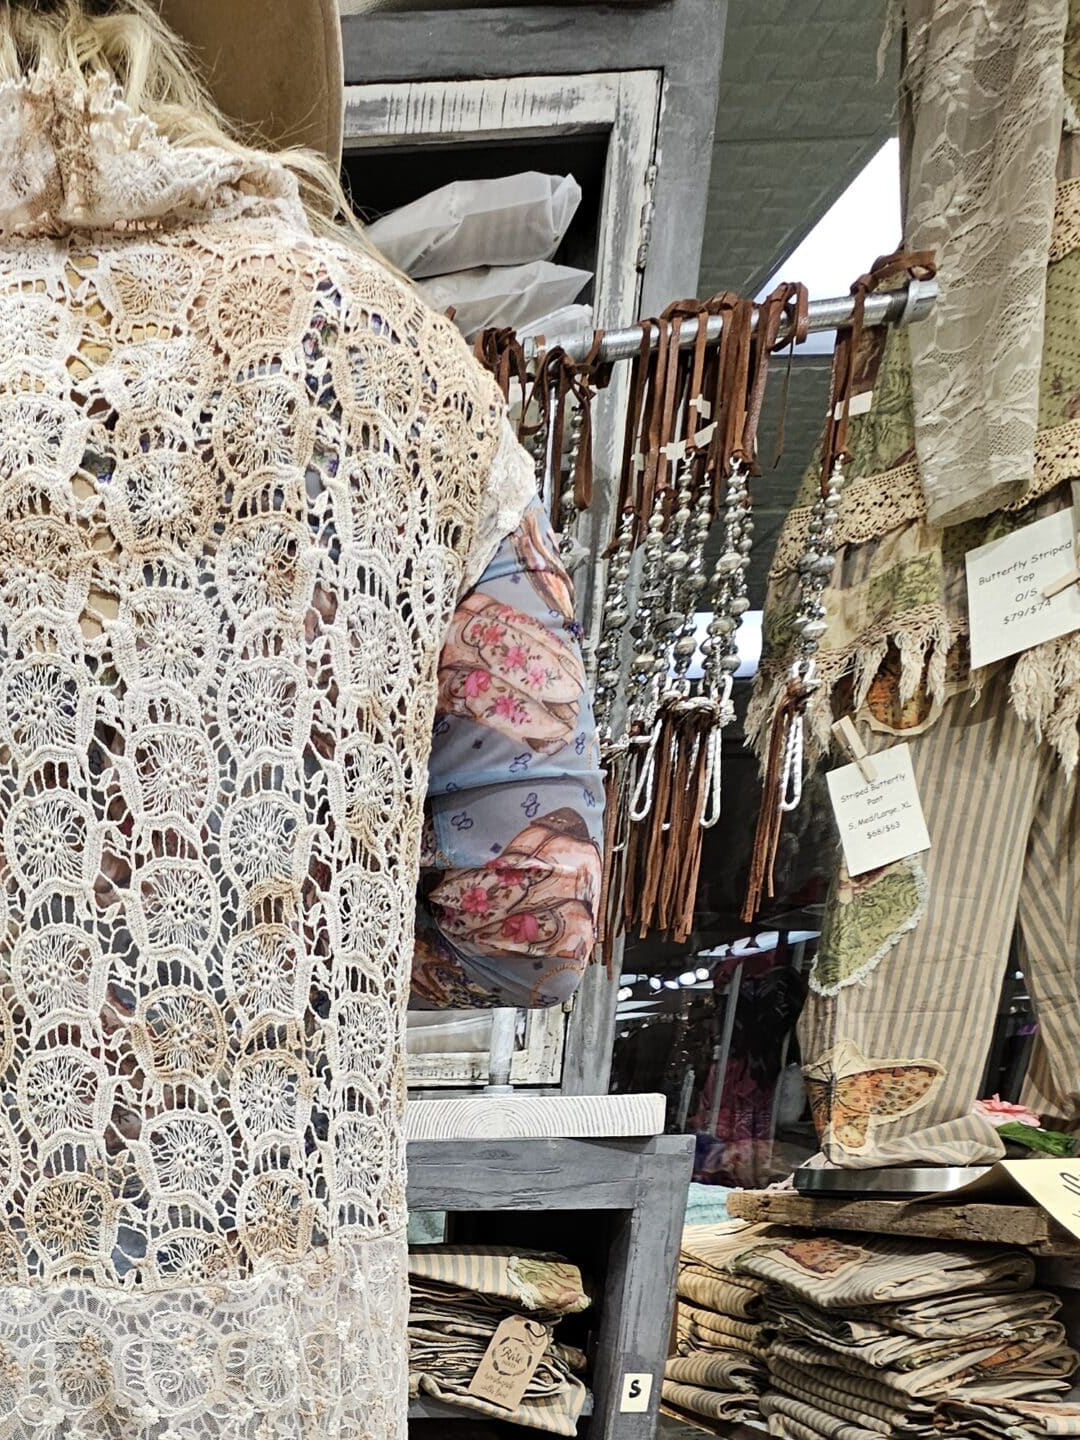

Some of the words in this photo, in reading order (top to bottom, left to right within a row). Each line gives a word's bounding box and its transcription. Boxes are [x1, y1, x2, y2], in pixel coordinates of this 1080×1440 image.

[978, 560, 1028, 586] Butterfly
[1030, 540, 1073, 564] Striped
[1016, 572, 1036, 585] Top
[1002, 599, 1052, 625] $79/$74
[840, 787, 869, 804] Striped
[870, 773, 906, 792] Butterfly
[866, 795, 884, 807] Pant
[901, 800, 912, 811] XL
[628, 1379, 642, 1398] S
